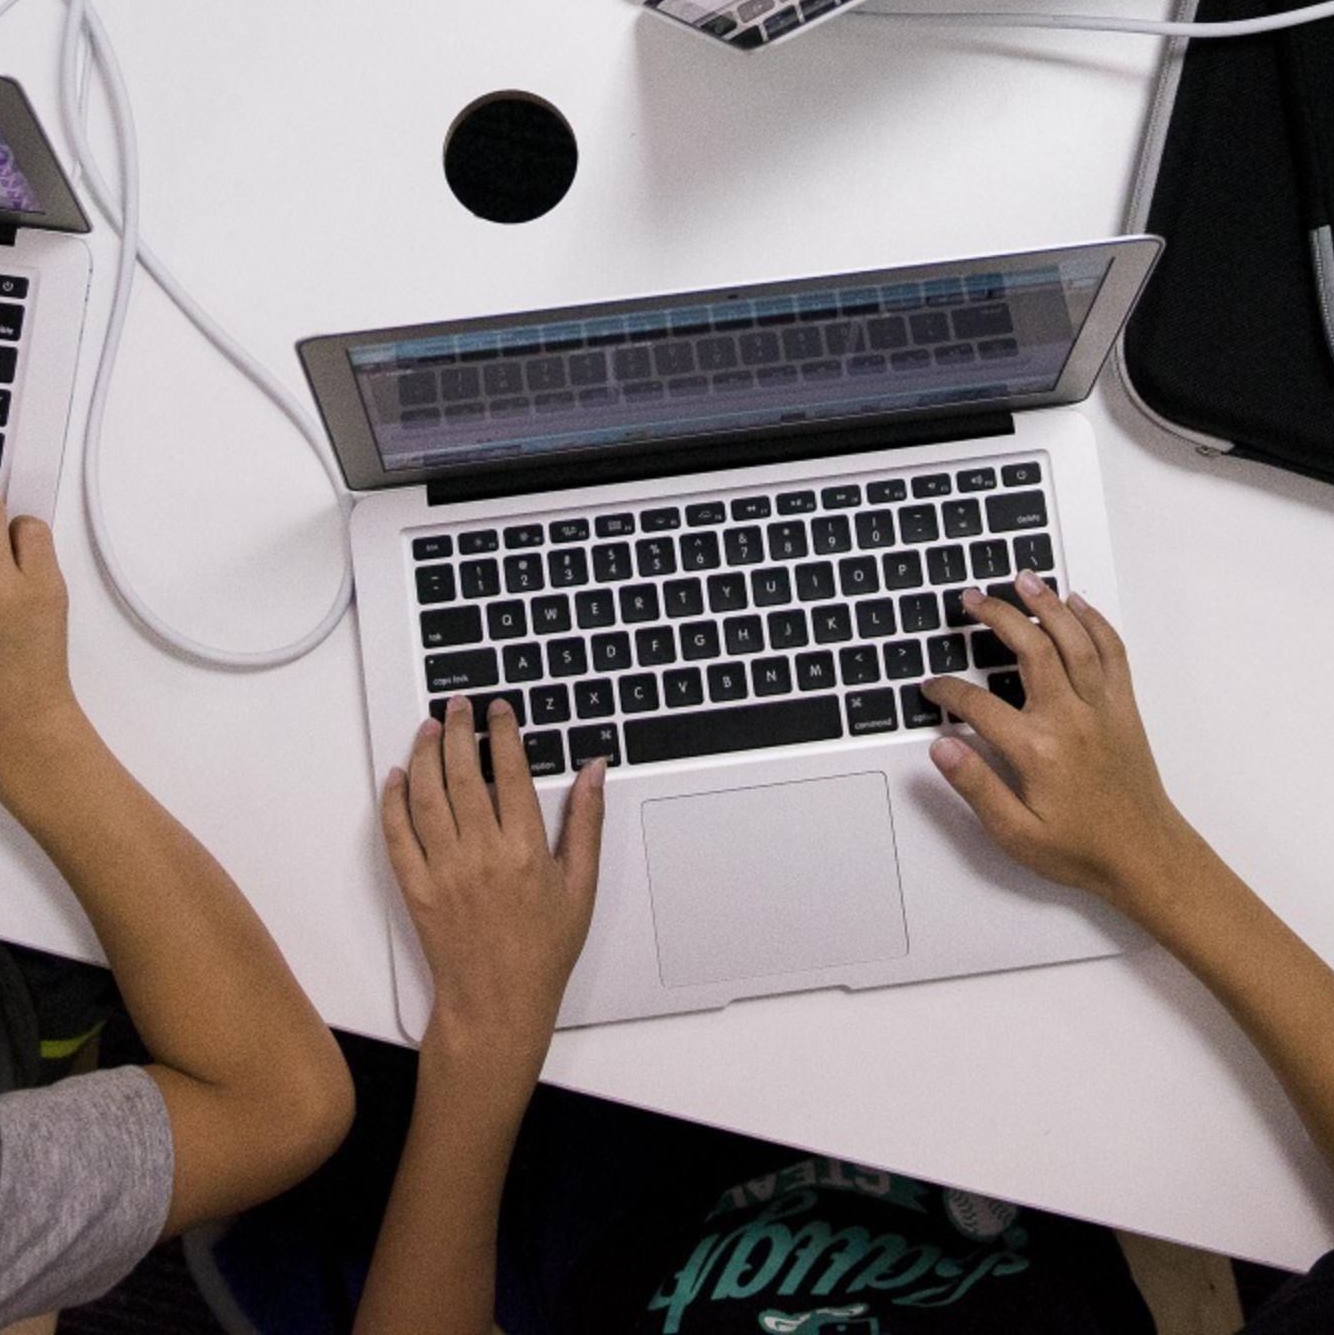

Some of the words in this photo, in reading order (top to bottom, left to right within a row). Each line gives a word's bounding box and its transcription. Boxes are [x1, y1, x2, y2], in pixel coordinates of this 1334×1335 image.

[477, 580, 484, 591] 1
[520, 574, 528, 586] 2
[565, 569, 573, 580] 3
[609, 563, 617, 574] 4
[653, 558, 661, 570] 5
[696, 553, 704, 564] 6
[741, 546, 748, 558] 7
[784, 541, 792, 553] 8
[828, 536, 836, 547] 9
[872, 530, 880, 542] 0
[502, 614, 513, 626] Q
[544, 608, 557, 620] W
[591, 602, 599, 615] E
[634, 597, 643, 609] R
[679, 591, 686, 603] T
[722, 586, 730, 597] Y
[766, 581, 776, 593] U
[812, 575, 818, 587] I
[853, 570, 864, 582] O
[898, 564, 907, 576] P
[518, 657, 528, 669] A
[562, 650, 572, 663] S
[606, 645, 616, 658] D
[652, 640, 659, 651] F
[694, 634, 705, 646] G
[738, 629, 749, 640] H
[785, 623, 792, 636] J
[827, 617, 837, 629] K
[872, 612, 880, 624] L
[546, 697, 555, 710] Z
[590, 692, 599, 705] X
[634, 686, 644, 699] C
[678, 681, 687, 693] V
[722, 676, 732, 688] B
[766, 670, 777, 682] N
[810, 664, 822, 677] M
